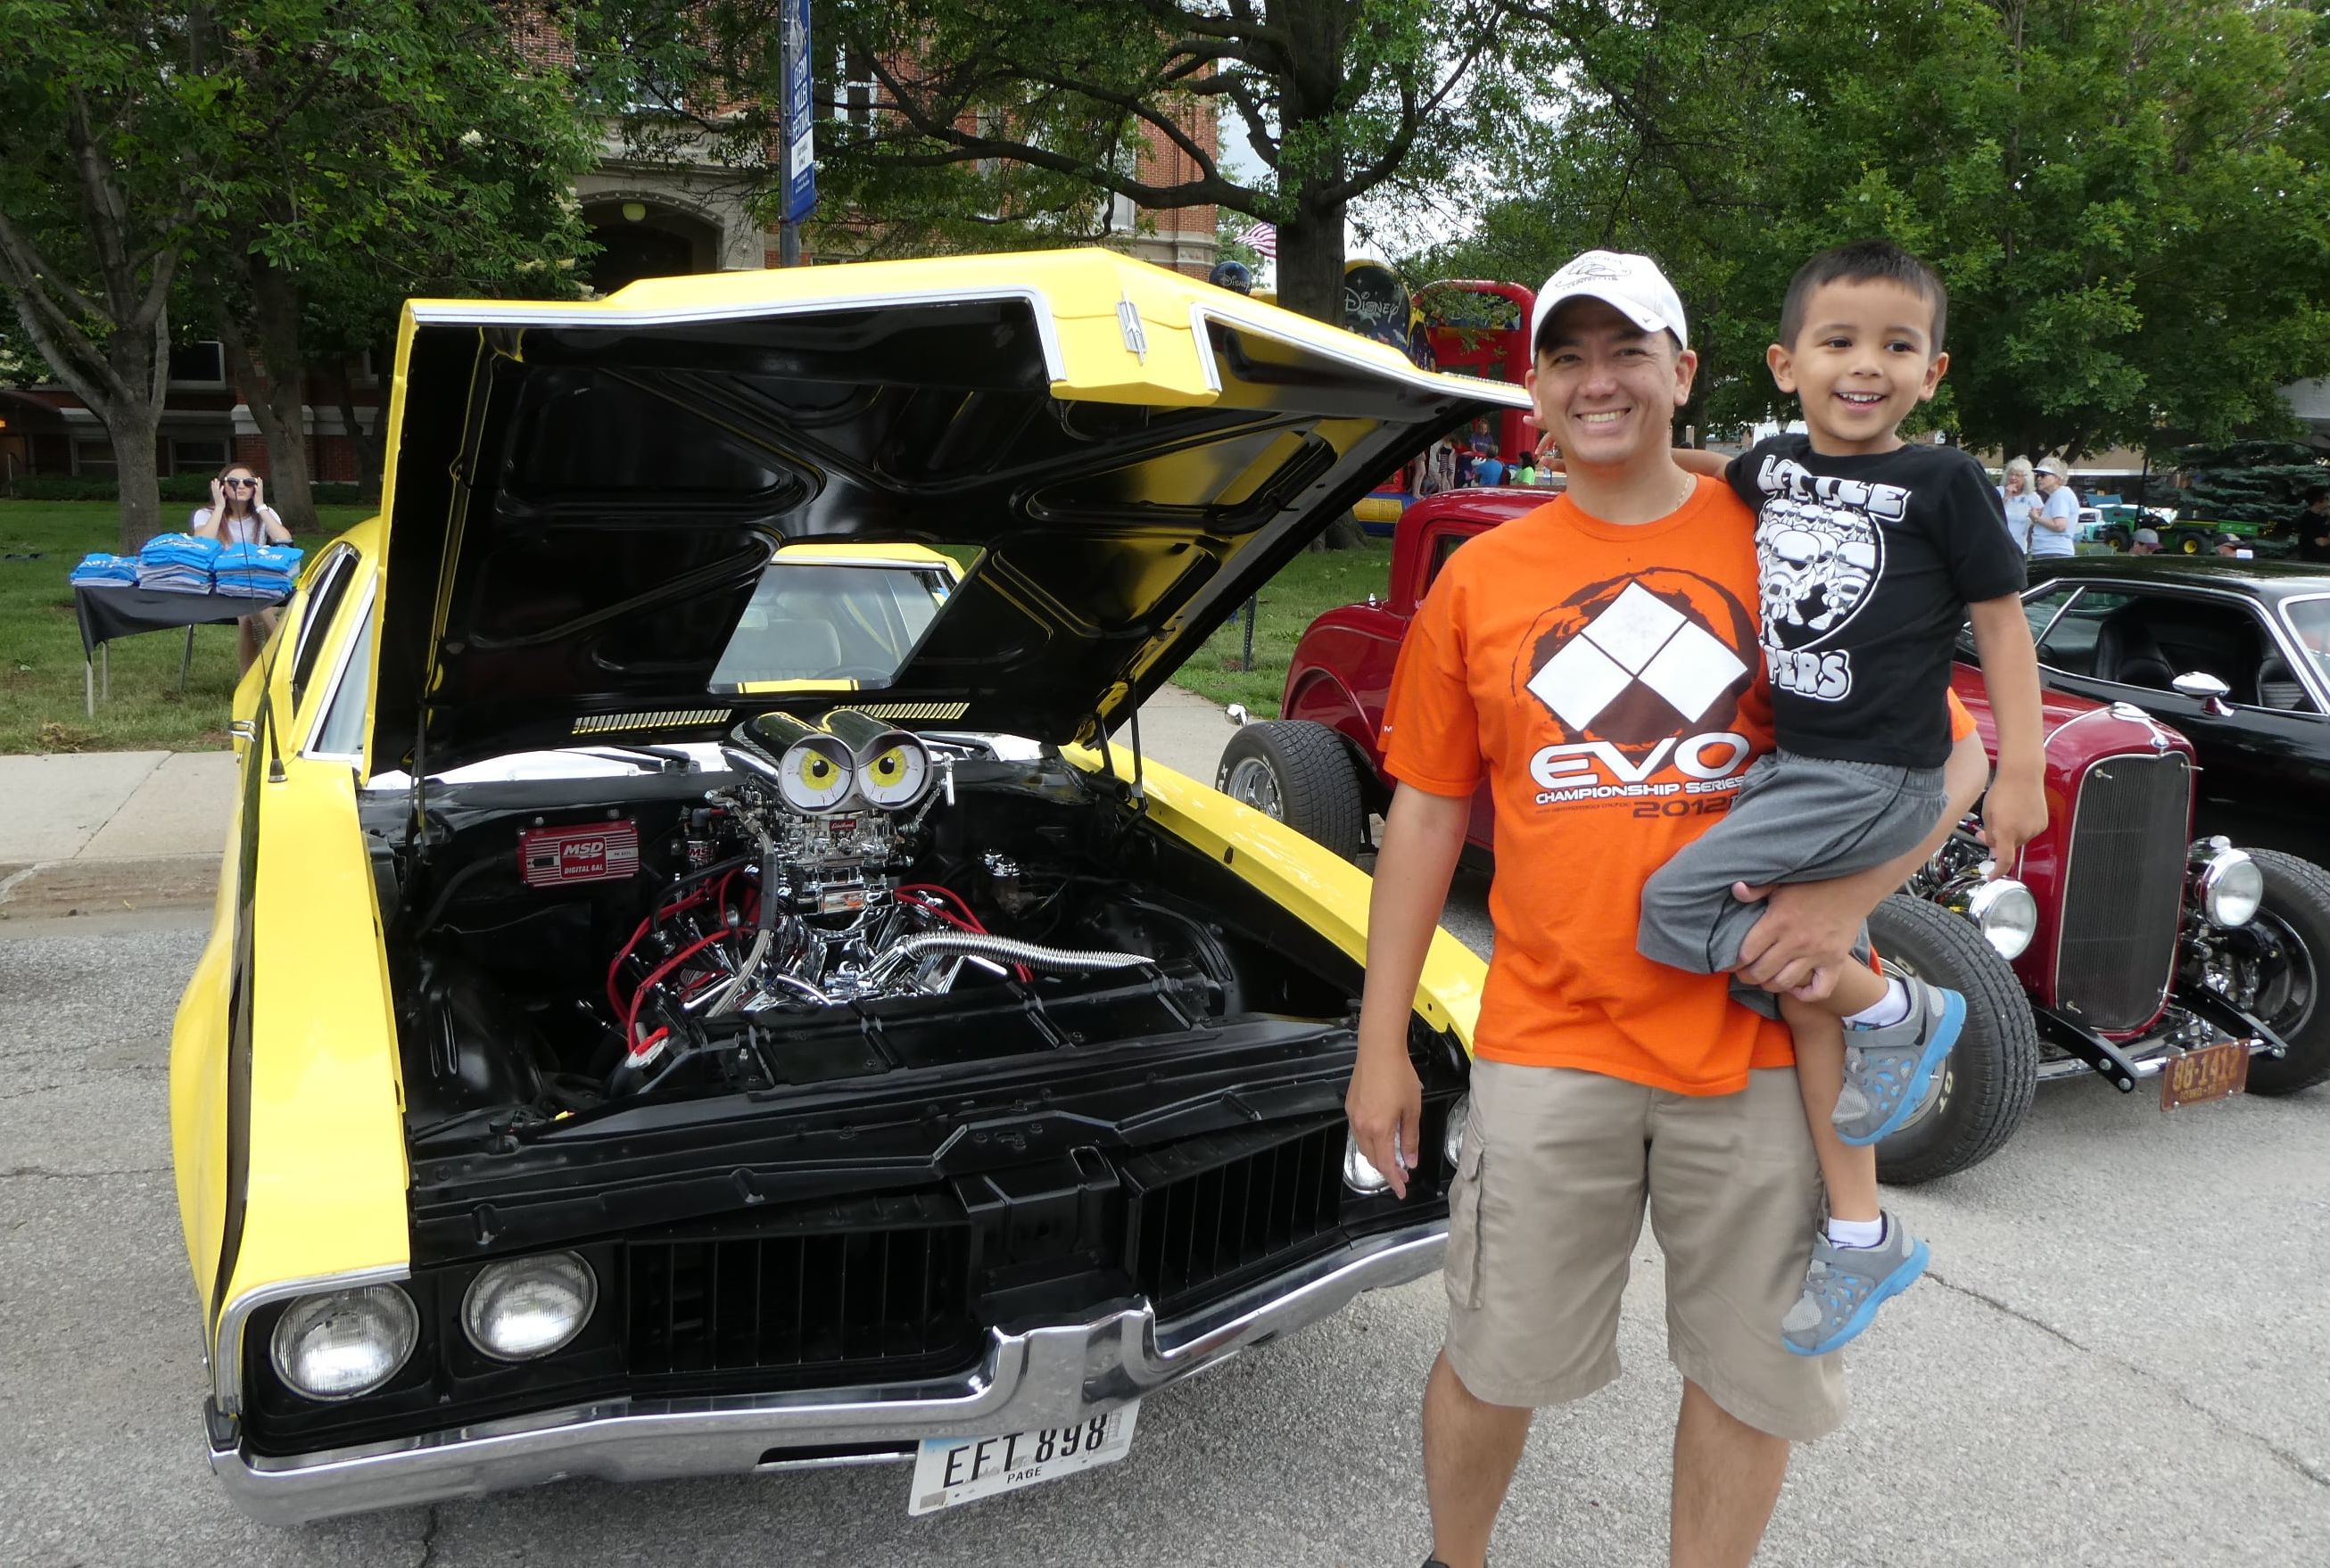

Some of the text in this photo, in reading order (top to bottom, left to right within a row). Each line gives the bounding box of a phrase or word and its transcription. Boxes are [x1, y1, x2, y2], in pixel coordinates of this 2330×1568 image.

[794, 54, 807, 89] GLENN
[794, 80, 808, 115] MILLER
[793, 104, 811, 143] FESTIVAL
[1529, 731, 1750, 788] EVO
[1535, 774, 1744, 805] CHAMPIONSHIP SERIES
[1632, 796, 1729, 818] 2012
[563, 841, 604, 857] MSD
[564, 866, 590, 874] DIGITAL
[943, 1413, 1107, 1489] EFT 898
[1006, 1465, 1043, 1484] PAGE
